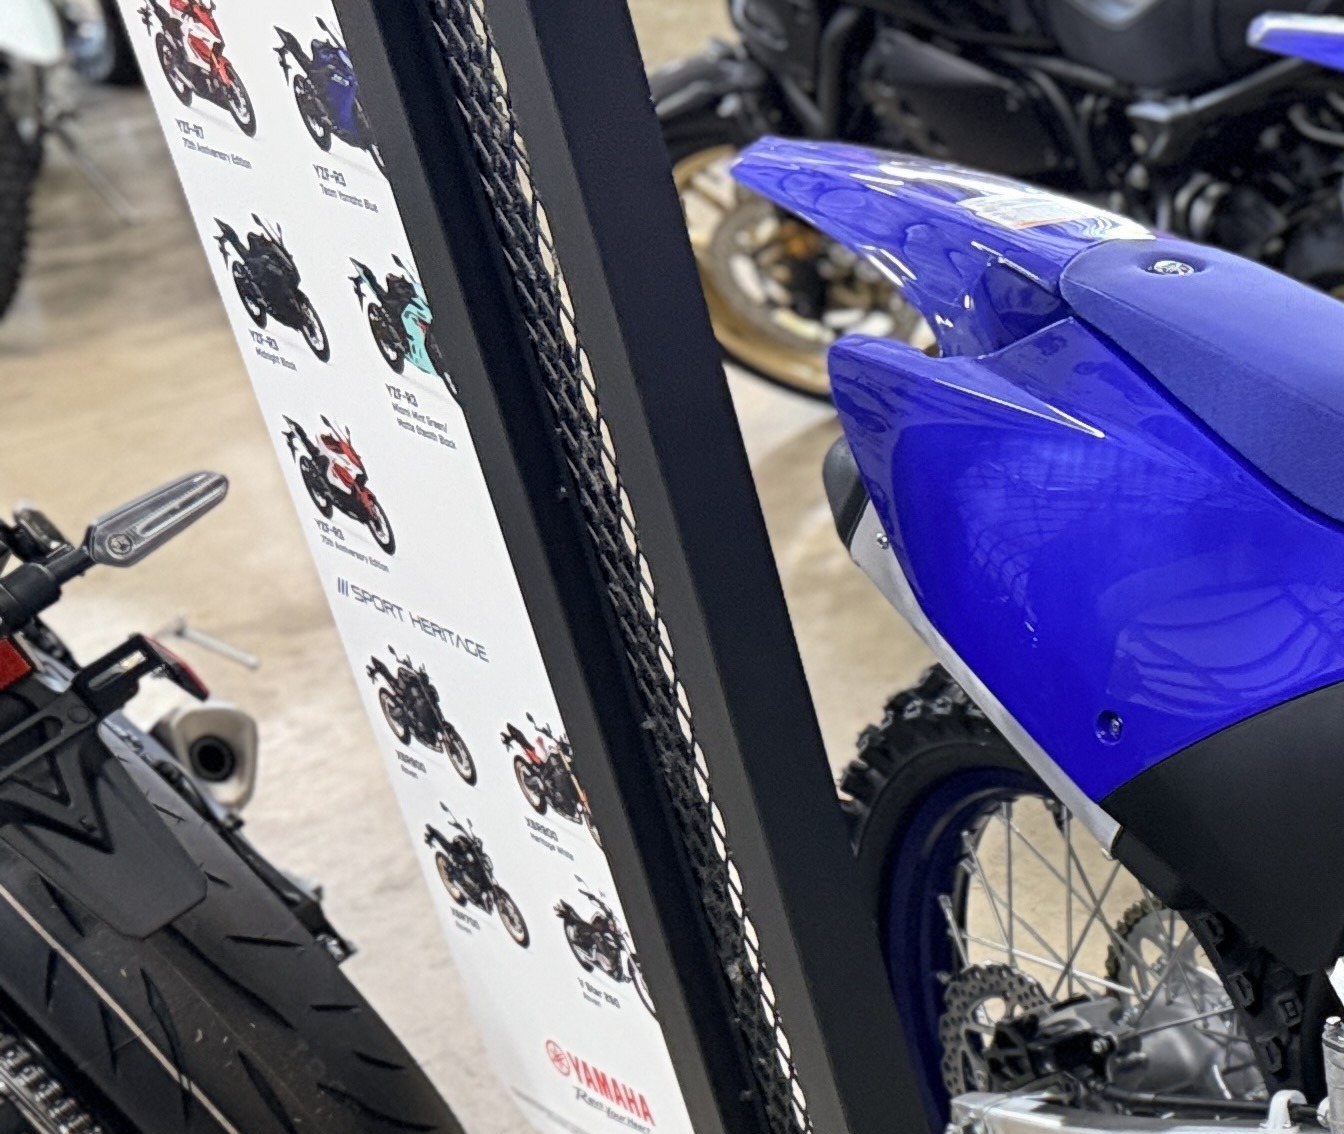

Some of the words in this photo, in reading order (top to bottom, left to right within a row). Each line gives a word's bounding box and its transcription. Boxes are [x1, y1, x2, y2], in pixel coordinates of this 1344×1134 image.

[350, 584, 404, 622] SPORT
[409, 611, 490, 663] HERITAGE
[567, 1050, 656, 1127] YAMAHA
